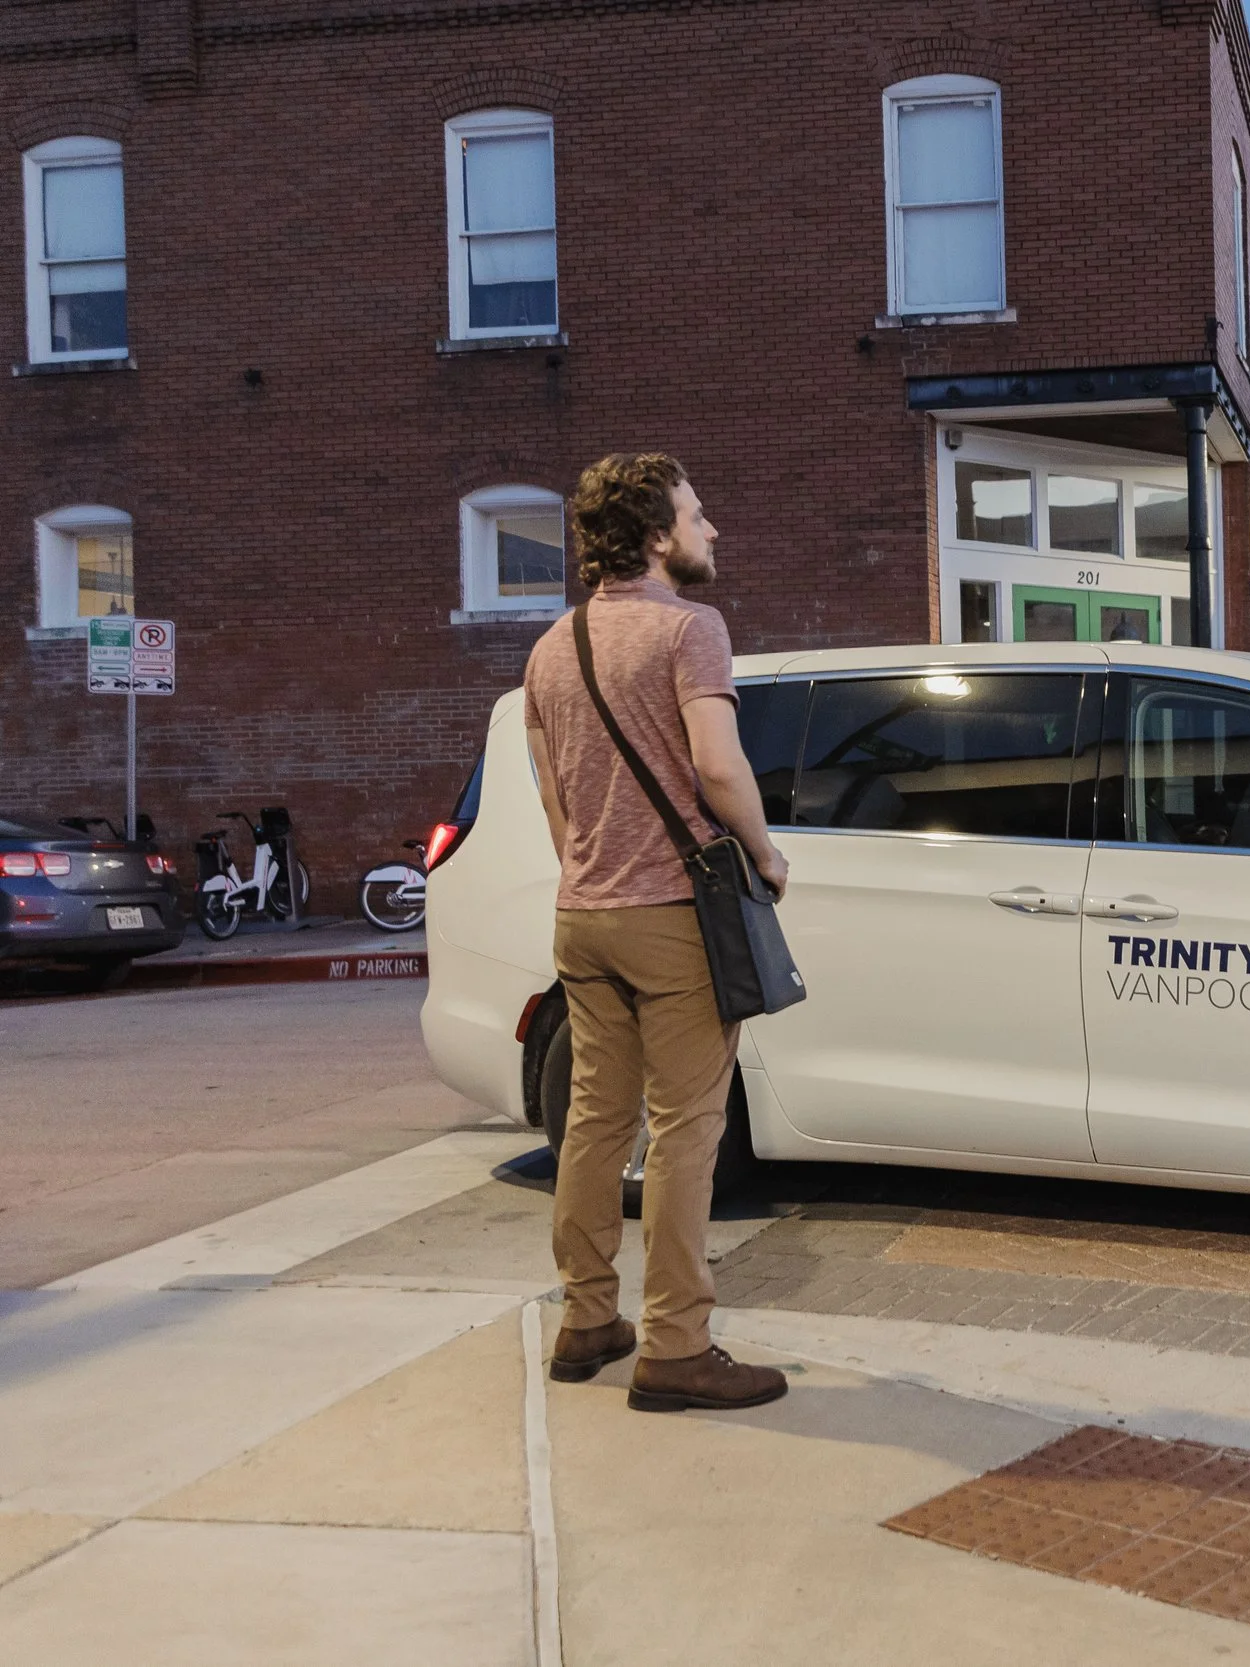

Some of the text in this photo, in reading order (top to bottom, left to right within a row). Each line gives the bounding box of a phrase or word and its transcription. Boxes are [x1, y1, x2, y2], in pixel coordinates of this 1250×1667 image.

[1077, 571, 1100, 585] 201
[329, 958, 420, 979] NO PARKING
